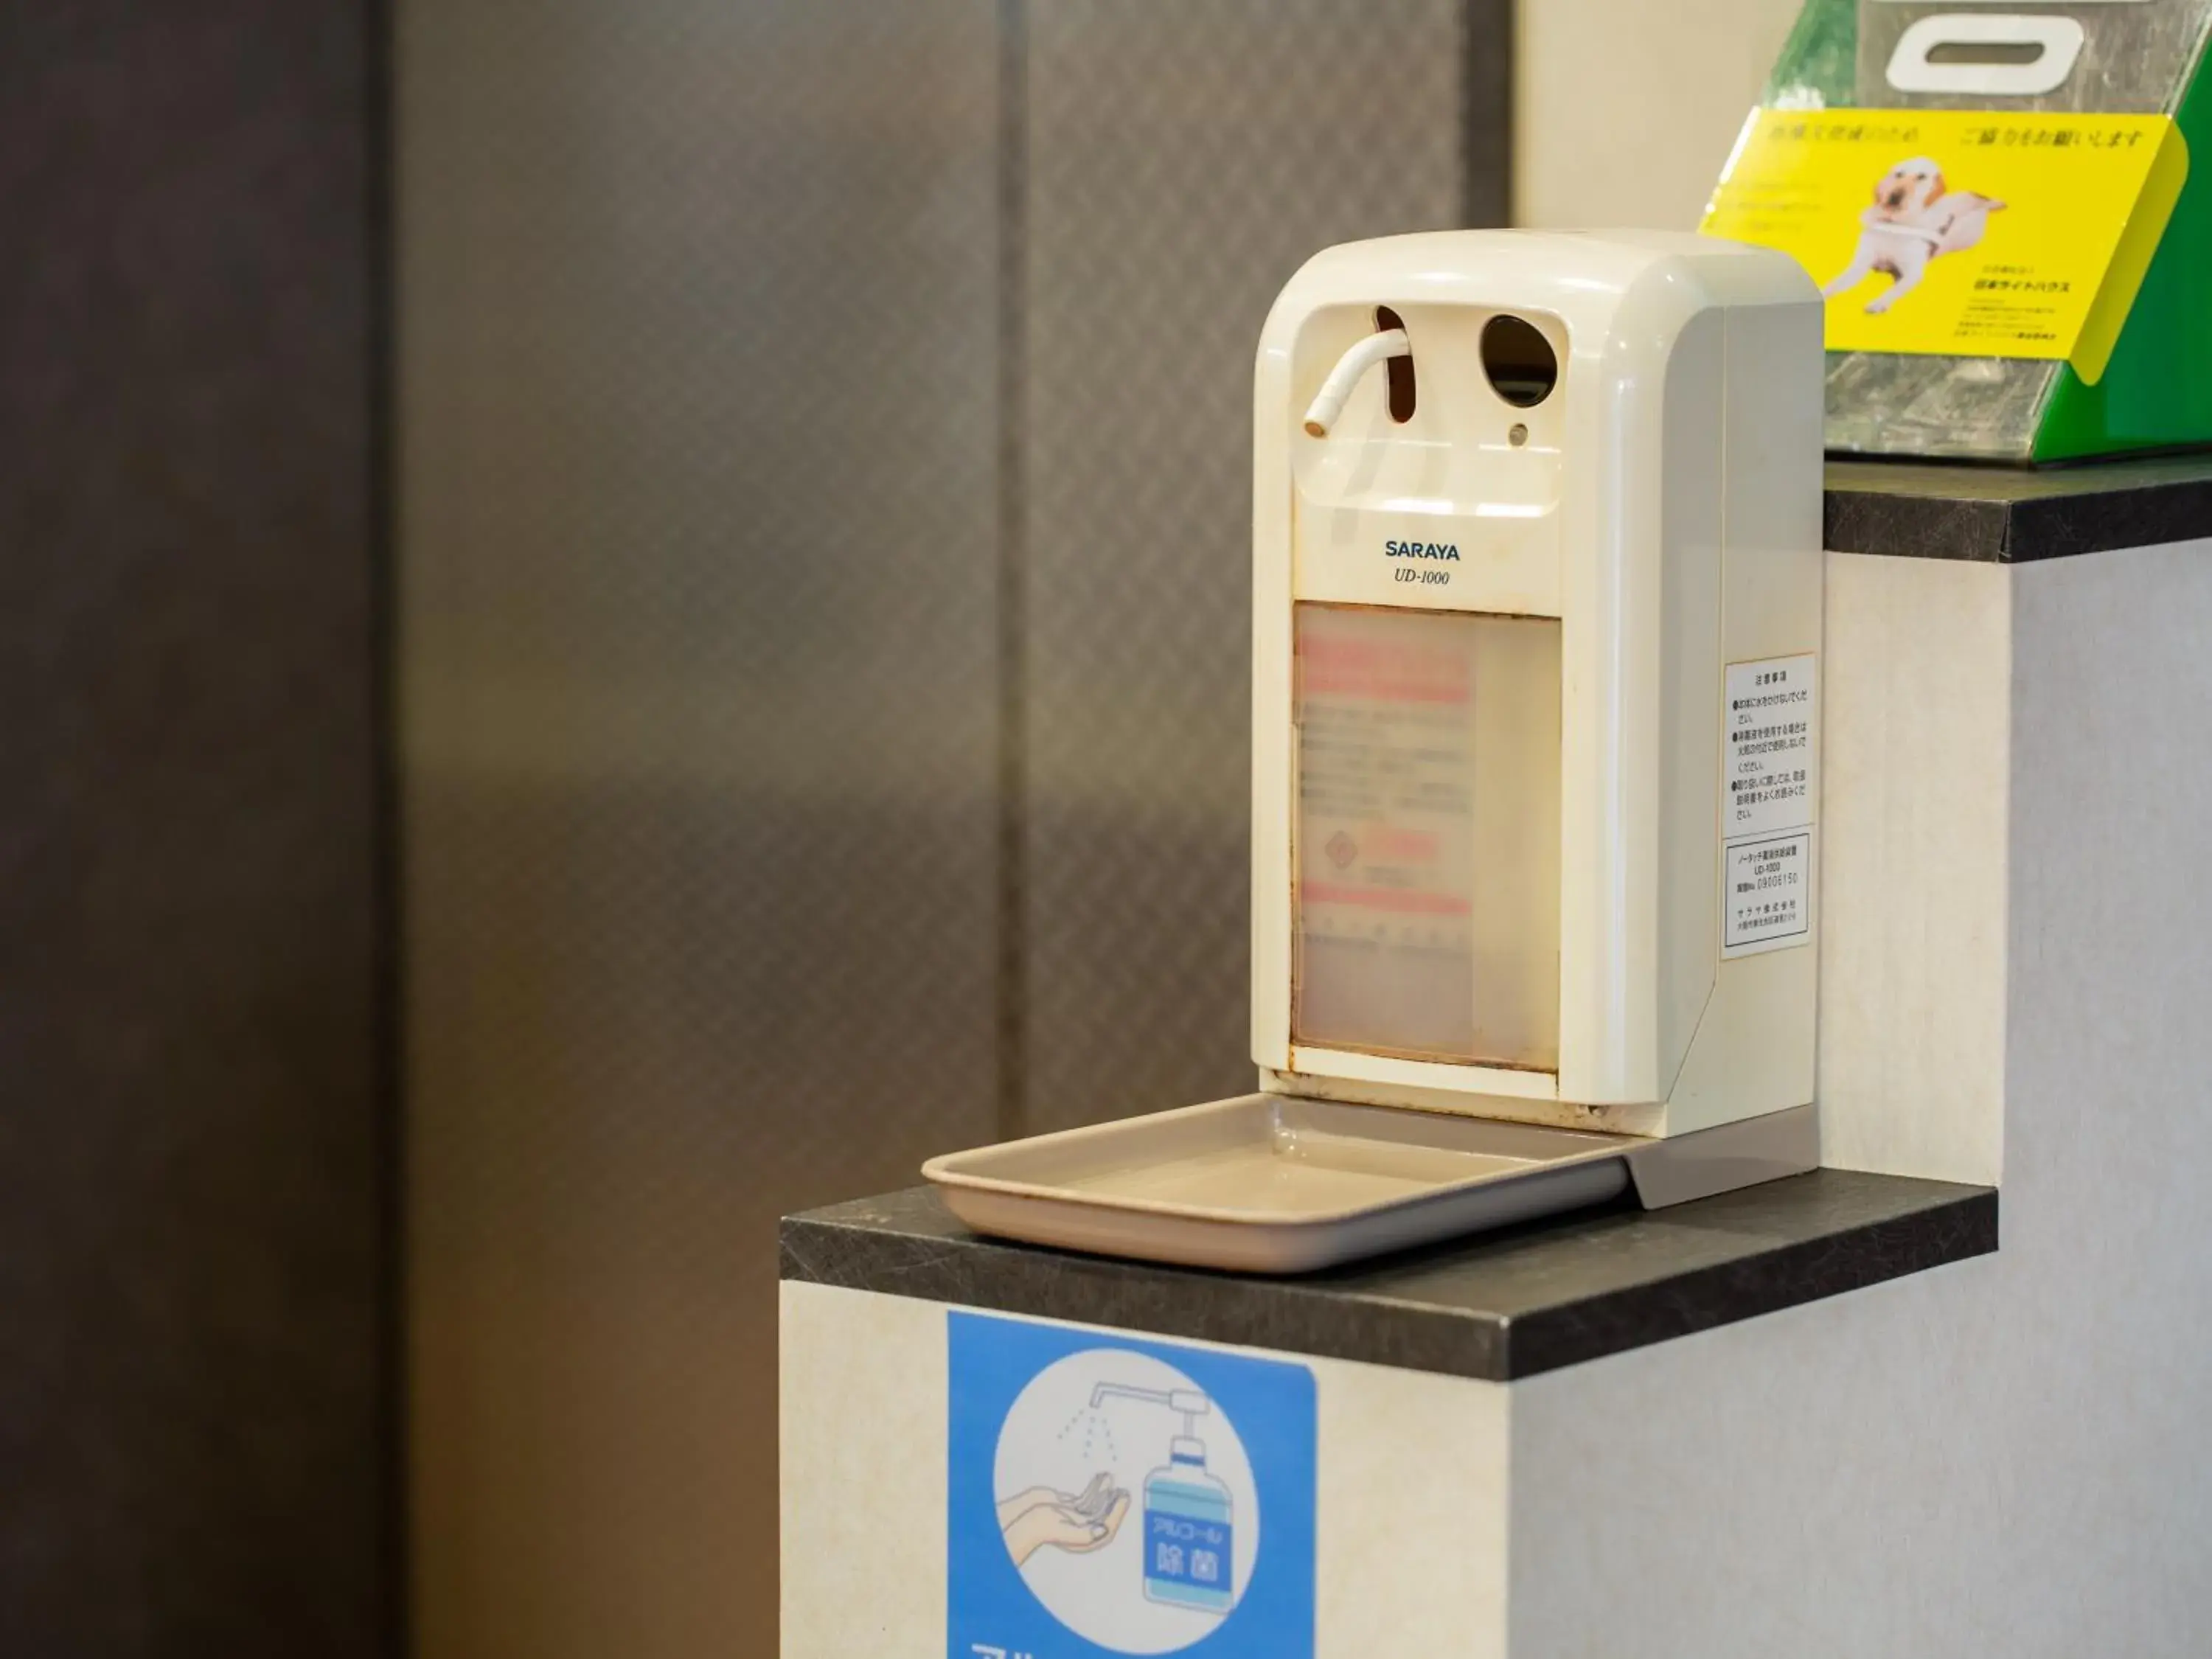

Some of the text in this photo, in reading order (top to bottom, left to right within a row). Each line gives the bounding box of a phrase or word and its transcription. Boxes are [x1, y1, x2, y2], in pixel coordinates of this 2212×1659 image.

[1385, 540, 1461, 561] SARAYA
[1394, 568, 1450, 585] UD-1000
[1153, 1517, 1223, 1545] アルコール
[1157, 1542, 1219, 1582] 除菌
